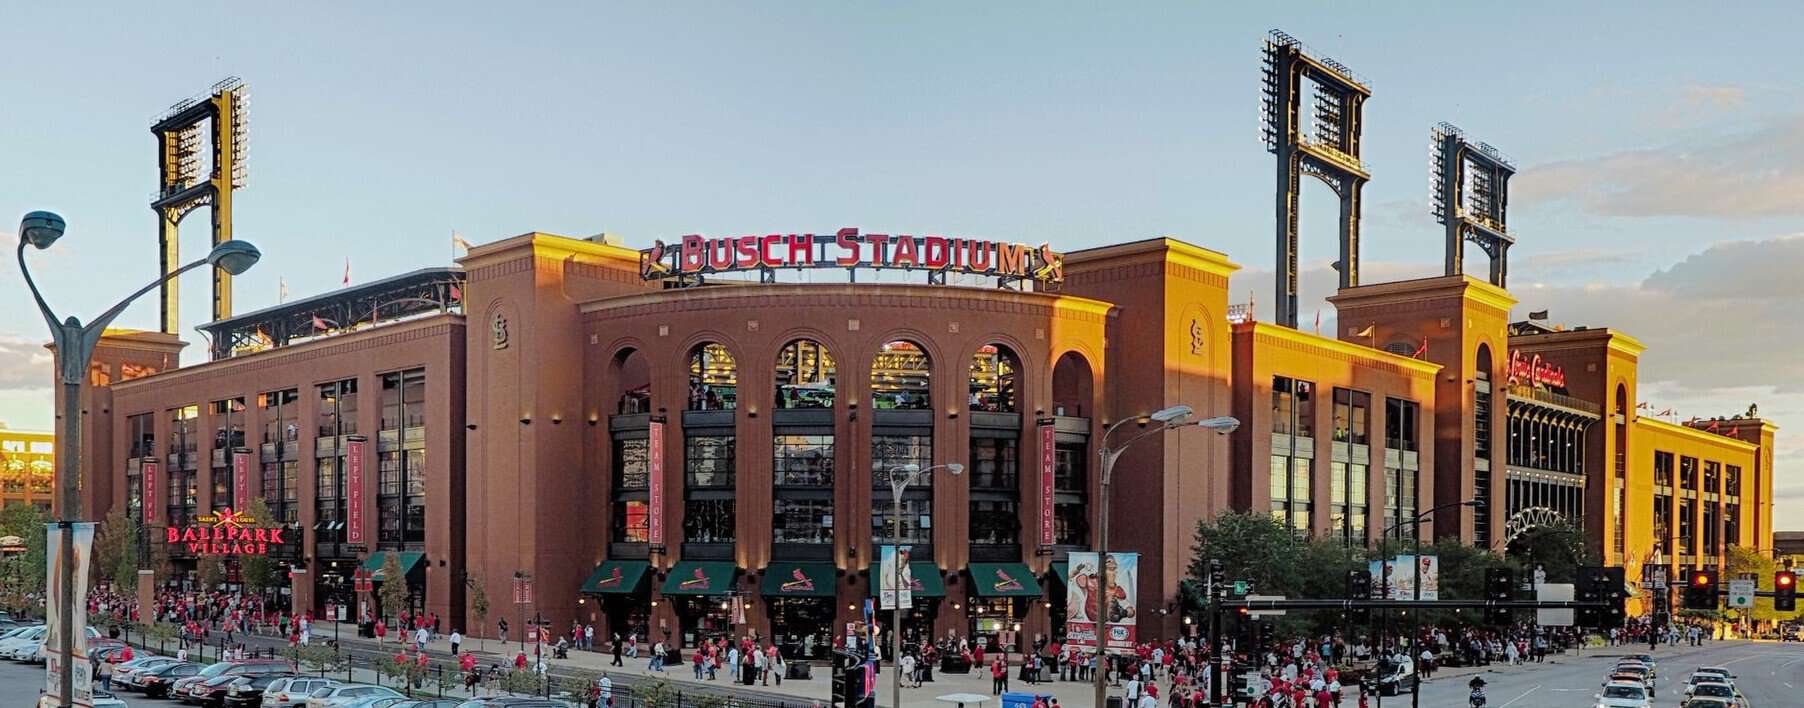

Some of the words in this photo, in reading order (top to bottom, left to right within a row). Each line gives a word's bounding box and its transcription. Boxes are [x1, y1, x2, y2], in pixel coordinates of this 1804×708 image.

[681, 234, 815, 272] BUSCH
[836, 227, 1026, 276] STADIUM
[351, 445, 360, 484] LEFT
[652, 427, 661, 472] TEAM
[1044, 429, 1052, 473] TEAM
[352, 490, 360, 540] FIELD
[652, 483, 661, 538] STORE
[167, 526, 285, 543] BALLPARK
[190, 543, 267, 554] VILLAGE
